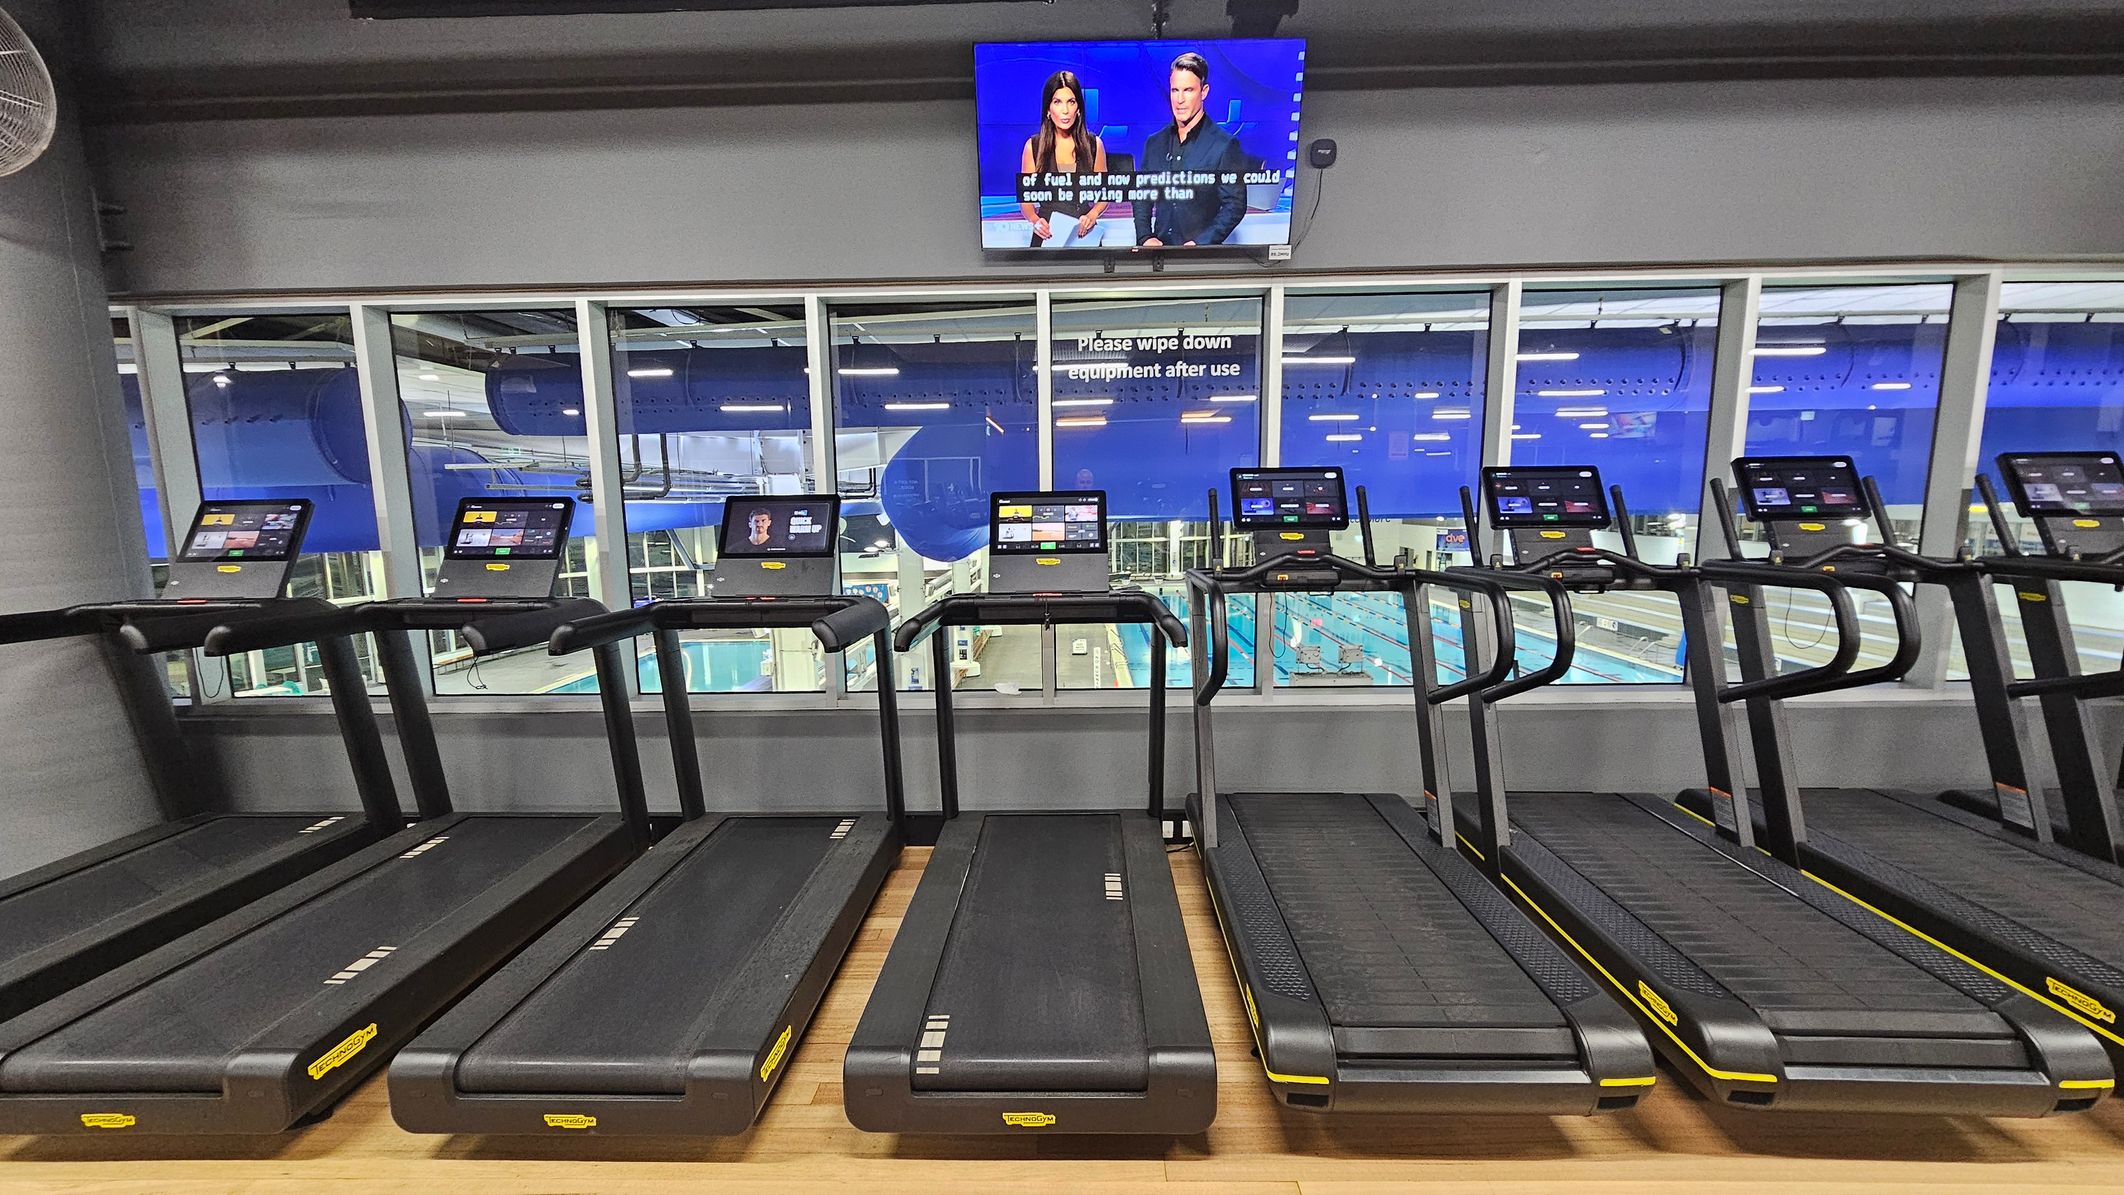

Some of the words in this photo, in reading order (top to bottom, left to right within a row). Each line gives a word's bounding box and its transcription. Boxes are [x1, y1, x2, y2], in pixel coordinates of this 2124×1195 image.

[1022, 173, 1038, 186] of
[1044, 172, 1073, 185] fuel
[1079, 172, 1101, 186] and
[1107, 175, 1130, 185] now
[1136, 171, 1215, 187] predictions
[1221, 173, 1237, 184] we
[1243, 170, 1279, 184] could
[1023, 190, 1052, 201] soon
[1058, 188, 1073, 201] be
[1079, 189, 1123, 203] paying
[1128, 189, 1158, 200] more
[1164, 188, 1193, 200] than
[1077, 336, 1132, 351] Please
[1137, 336, 1179, 353] wipe
[1183, 335, 1232, 350] down
[1068, 363, 1161, 382] equipment
[1165, 361, 1206, 376] after
[1211, 363, 1241, 376] use
